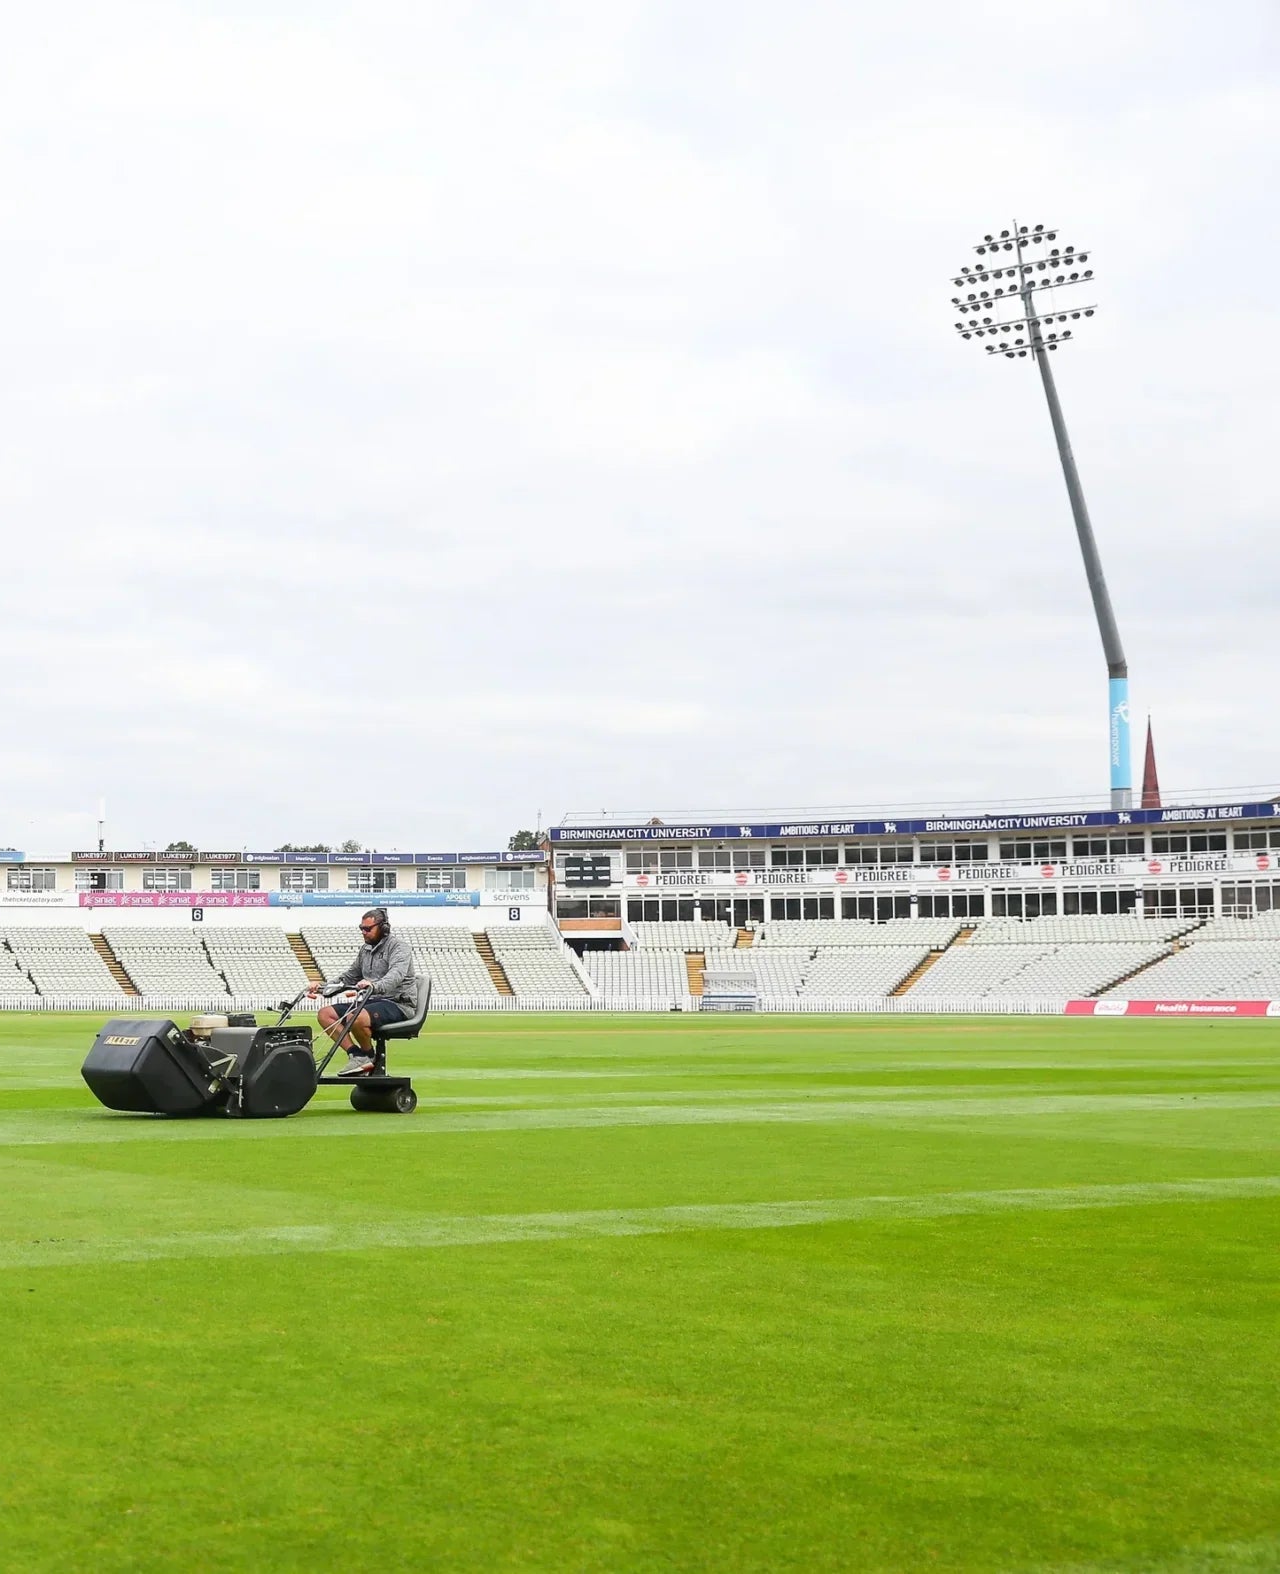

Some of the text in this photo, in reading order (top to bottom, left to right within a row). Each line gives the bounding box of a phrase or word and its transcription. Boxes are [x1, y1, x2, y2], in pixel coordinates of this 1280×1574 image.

[1162, 806, 1244, 821] AMBITIOUS AT HEART
[926, 815, 1088, 831] BIRMINGHAM CITY UNIVERSITY
[560, 828, 712, 840] BIRMINGHAM CITY UNIVERSITY
[780, 824, 854, 836] AMBITIOUS AT HEART
[1062, 864, 1116, 876] PEDIGREE
[1170, 860, 1226, 872] PEDIGREE
[656, 874, 706, 886] PEDIGREE
[755, 873, 806, 884] PEDIGREE
[855, 871, 908, 882] PEDIGREE
[958, 868, 1011, 880] PEDIGREE
[193, 910, 202, 920] 6
[510, 909, 519, 919] 8
[1155, 1003, 1188, 1013] Health
[107, 1036, 139, 1045] ALLETT
